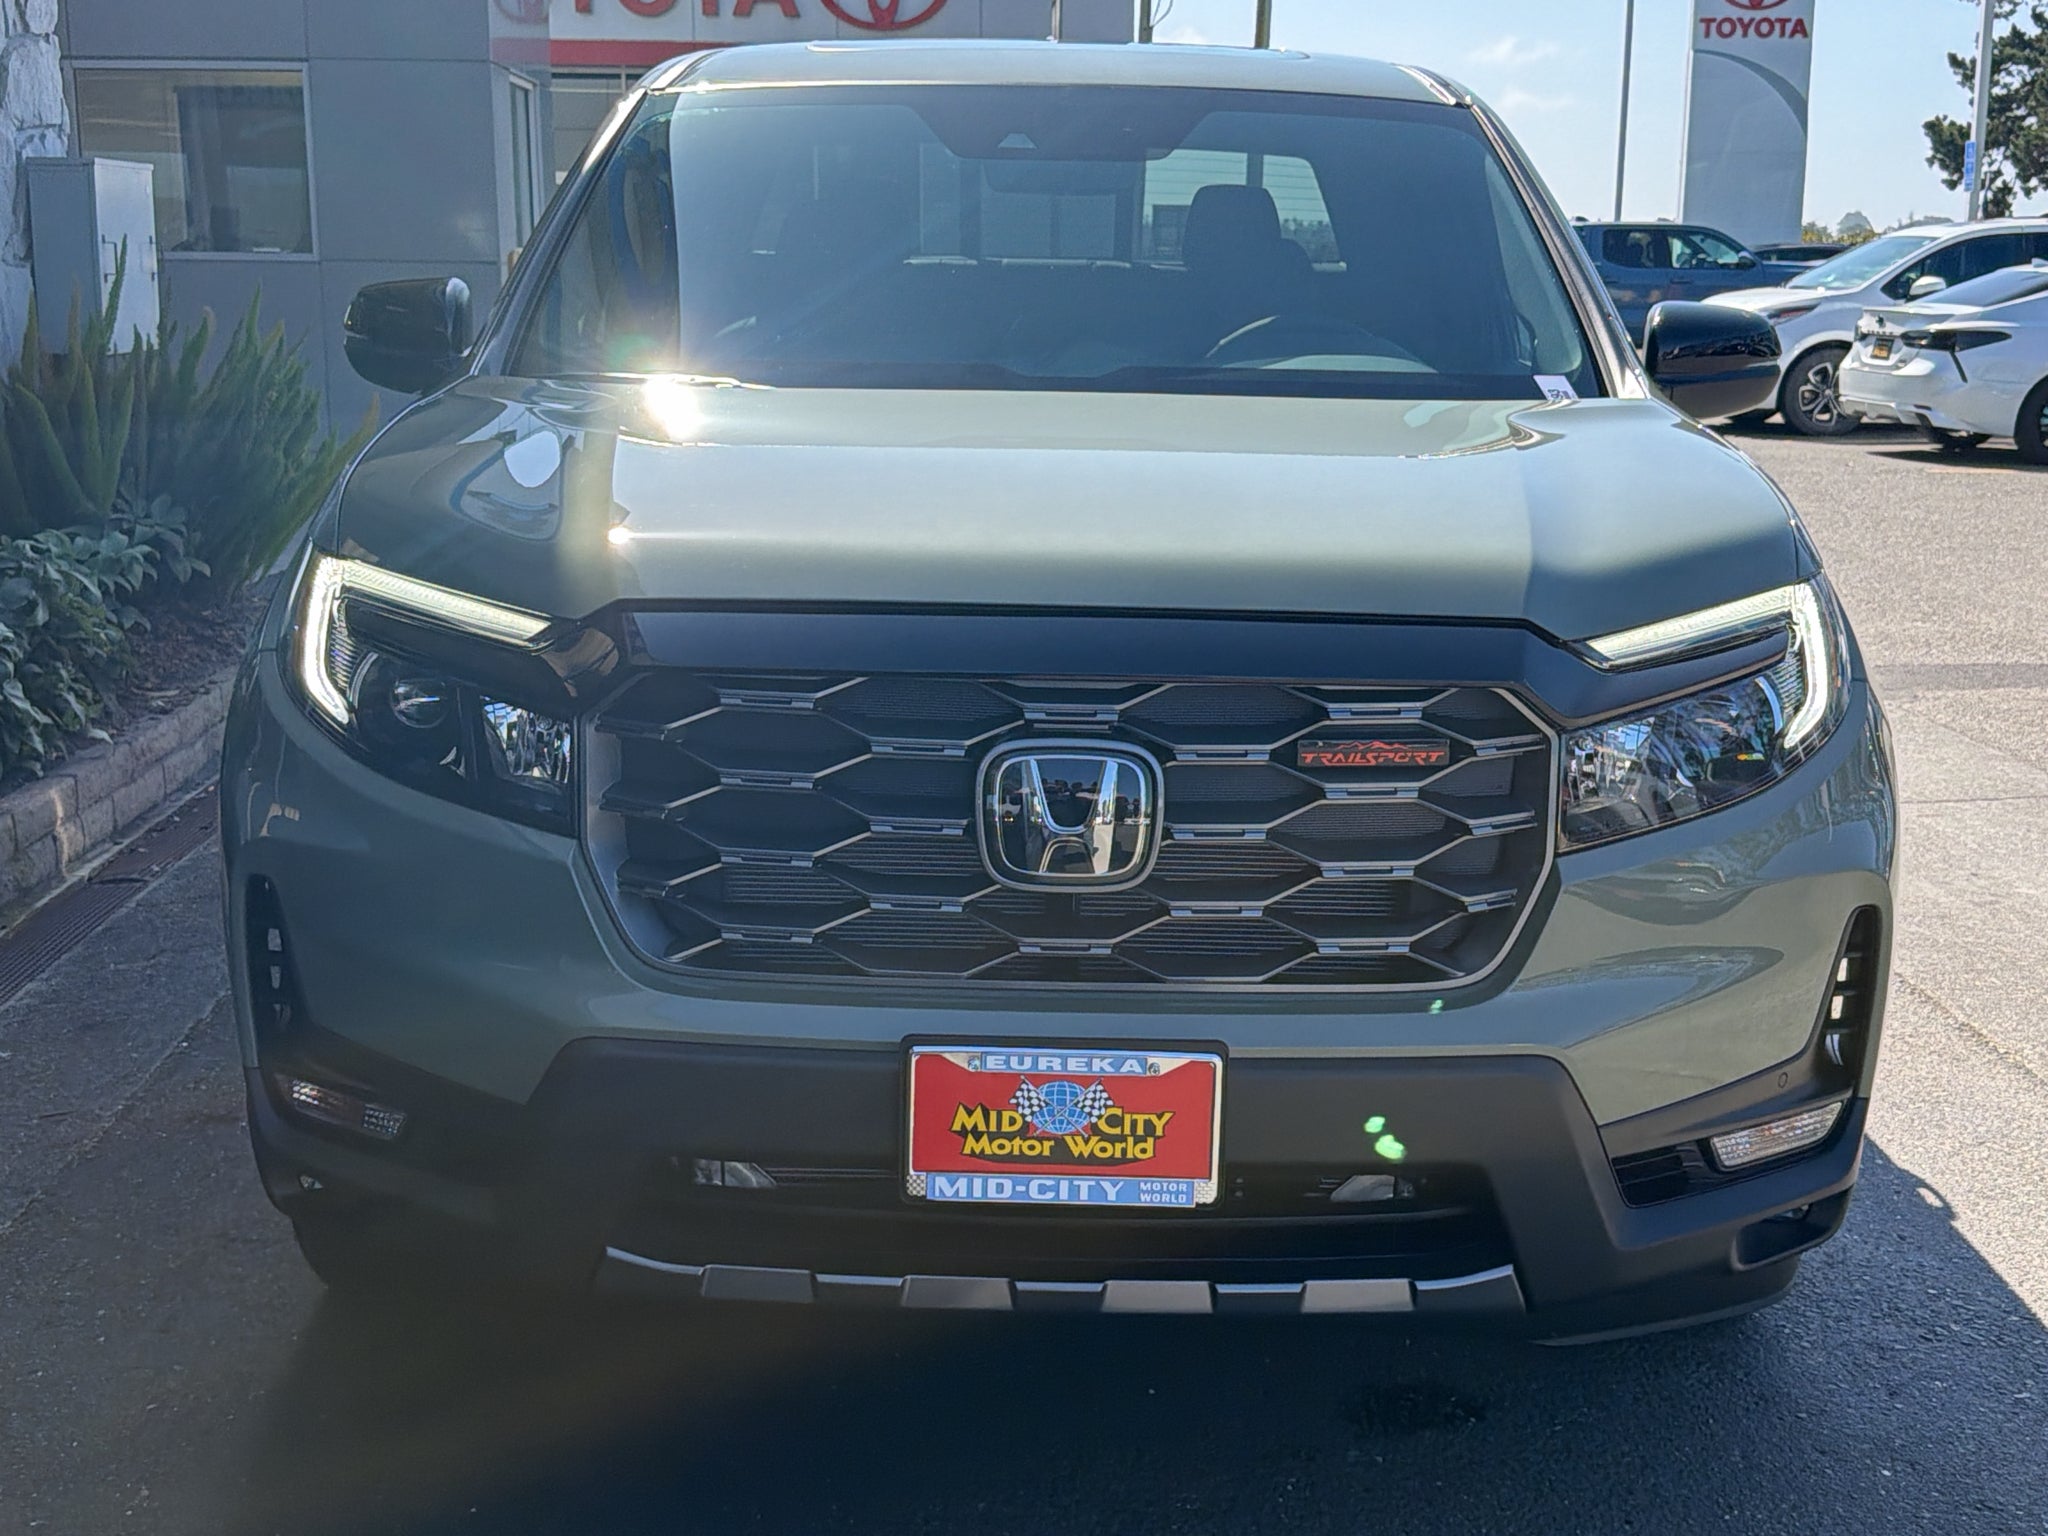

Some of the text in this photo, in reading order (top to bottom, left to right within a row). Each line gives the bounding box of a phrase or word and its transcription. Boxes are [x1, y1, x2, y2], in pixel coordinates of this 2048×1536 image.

[1698, 17, 1809, 39] TOYOTA
[1301, 751, 1445, 766] TRAILSPORT
[985, 1055, 1144, 1074] EUREKA
[951, 1104, 1175, 1137] MID CITY
[962, 1133, 1155, 1159] Motor World
[934, 1176, 1125, 1201] MID-CITY
[1139, 1181, 1188, 1192] MOTOR
[1139, 1192, 1188, 1203] WORLD
